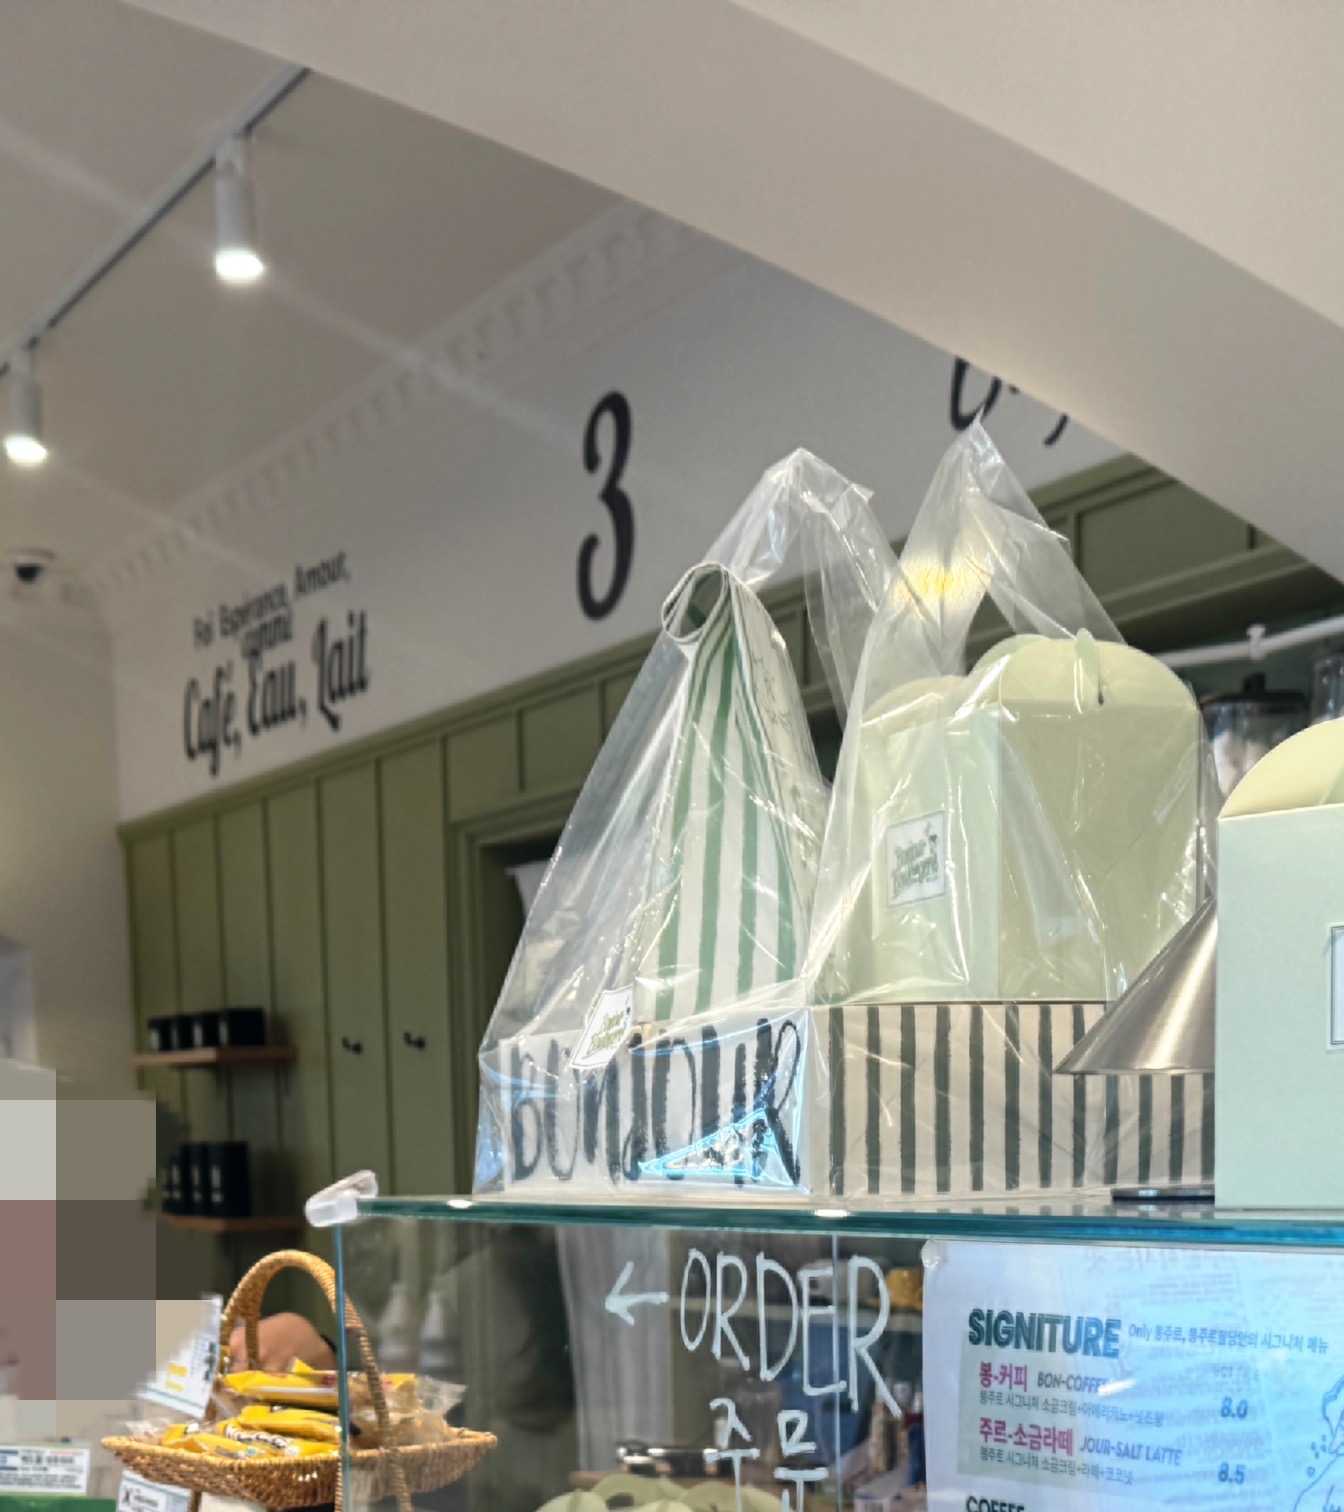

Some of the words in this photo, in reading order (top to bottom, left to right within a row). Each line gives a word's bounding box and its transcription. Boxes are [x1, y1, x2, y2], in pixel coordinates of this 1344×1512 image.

[576, 390, 635, 622] 3
[183, 660, 241, 778] Café,
[680, 1246, 903, 1416] ORDER
[968, 1308, 1121, 1358] SIGNITURE
[979, 1361, 1028, 1393] 봉-커피
[979, 1417, 1074, 1457] 주르-소금라떼
[1080, 1436, 1142, 1462] JOUR-SALT
[1145, 1444, 1183, 1467] LATTE
